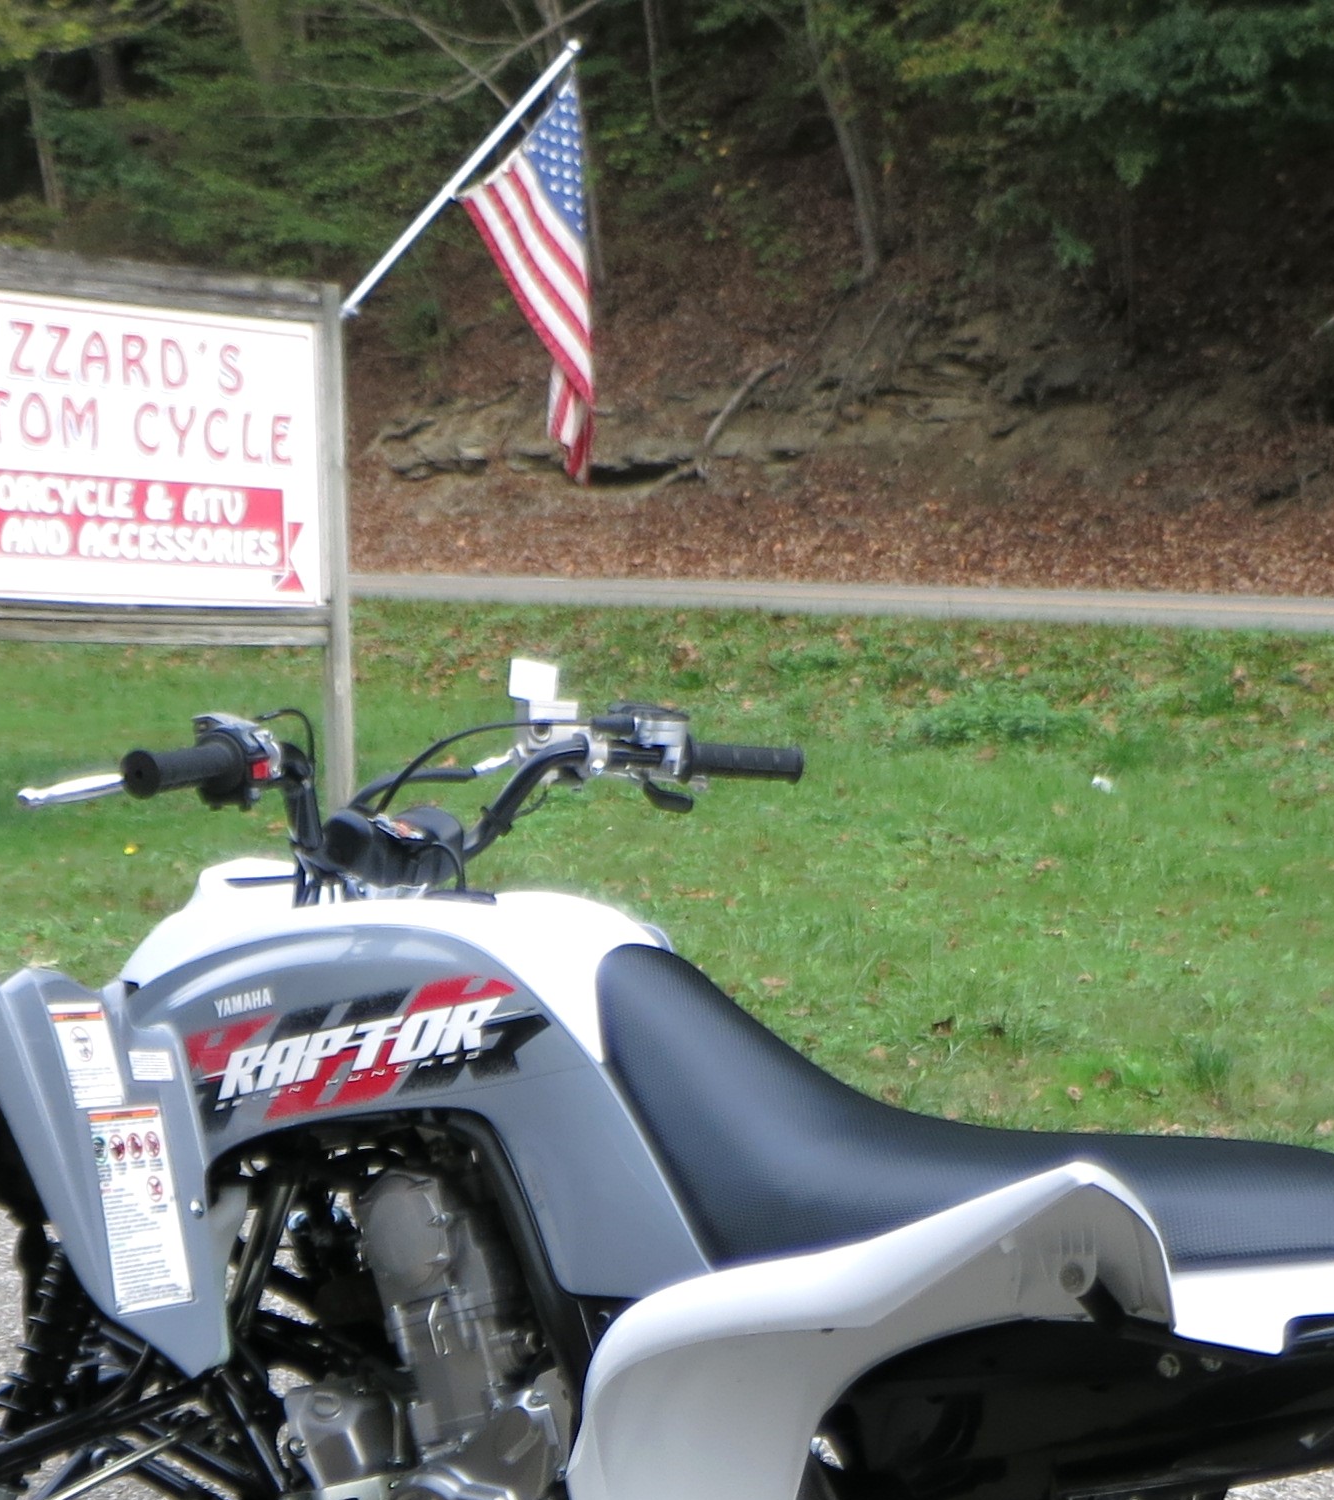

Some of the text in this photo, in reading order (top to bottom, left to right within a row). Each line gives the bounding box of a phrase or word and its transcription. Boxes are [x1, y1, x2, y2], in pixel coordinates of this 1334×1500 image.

[134, 402, 293, 466] CYCLE
[144, 490, 173, 521] &
[183, 488, 246, 524] ATV
[0, 518, 68, 556] AND
[78, 522, 279, 566] ACCESSORIES
[214, 988, 272, 1018] YAMAHA
[217, 997, 501, 1101] RAPTOR
